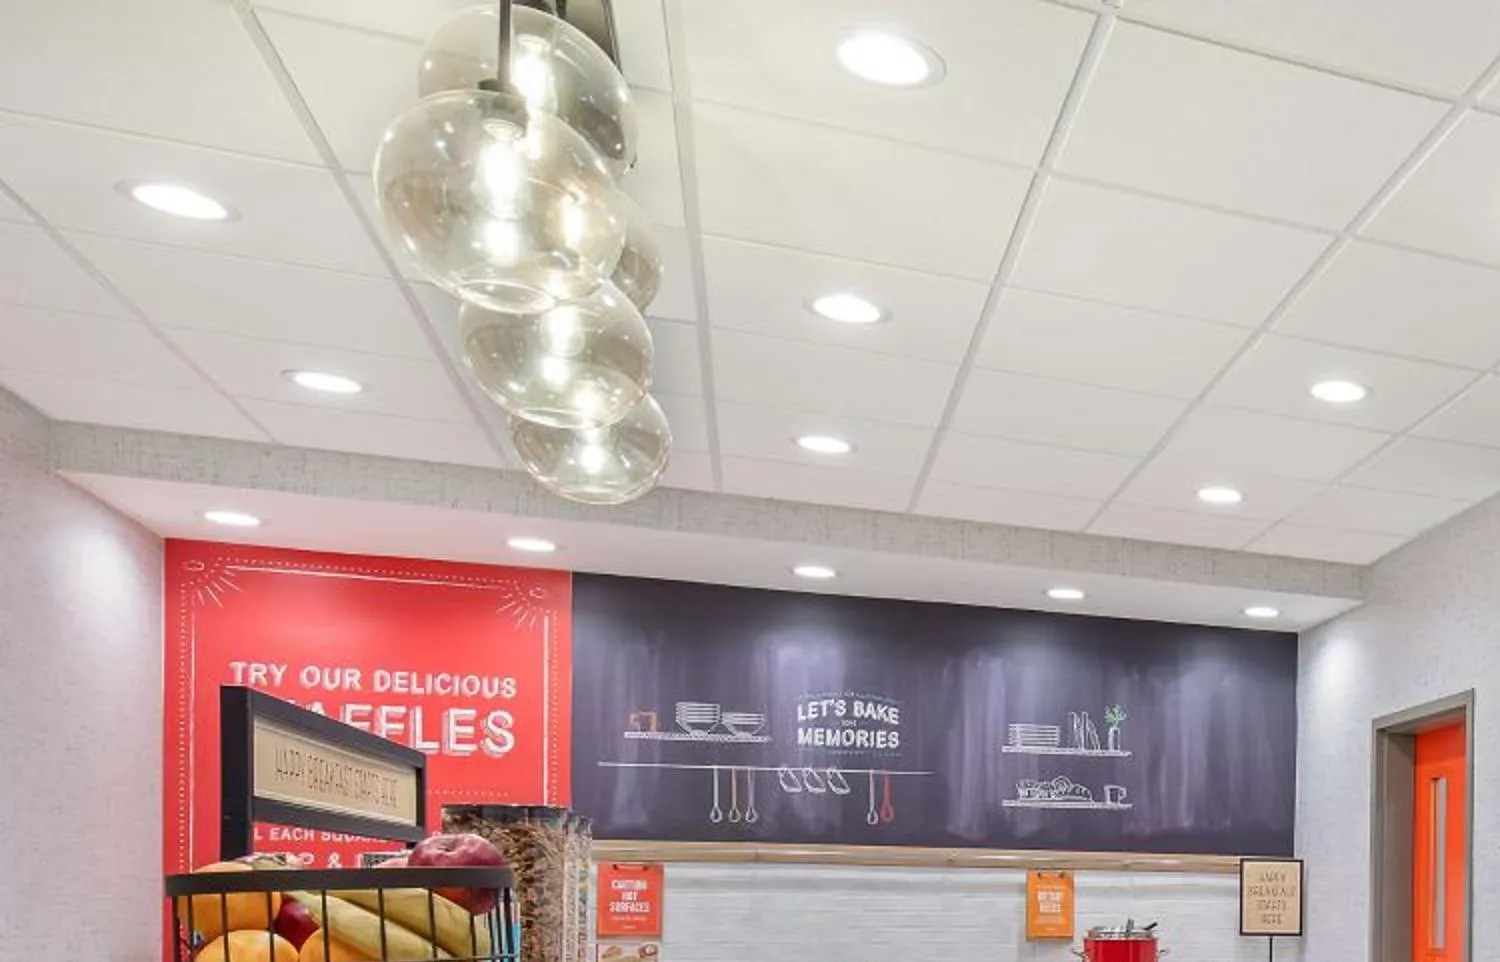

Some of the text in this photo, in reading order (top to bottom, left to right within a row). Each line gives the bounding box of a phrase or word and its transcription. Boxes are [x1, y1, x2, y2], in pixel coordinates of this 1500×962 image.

[228, 661, 517, 699] TRY OUR DELICIOUS
[797, 698, 899, 725] LET'S BAKE
[285, 699, 515, 757] FFLES
[797, 727, 899, 749] MEMORIES
[270, 827, 315, 841] EACH
[609, 902, 650, 913] SURFACES
